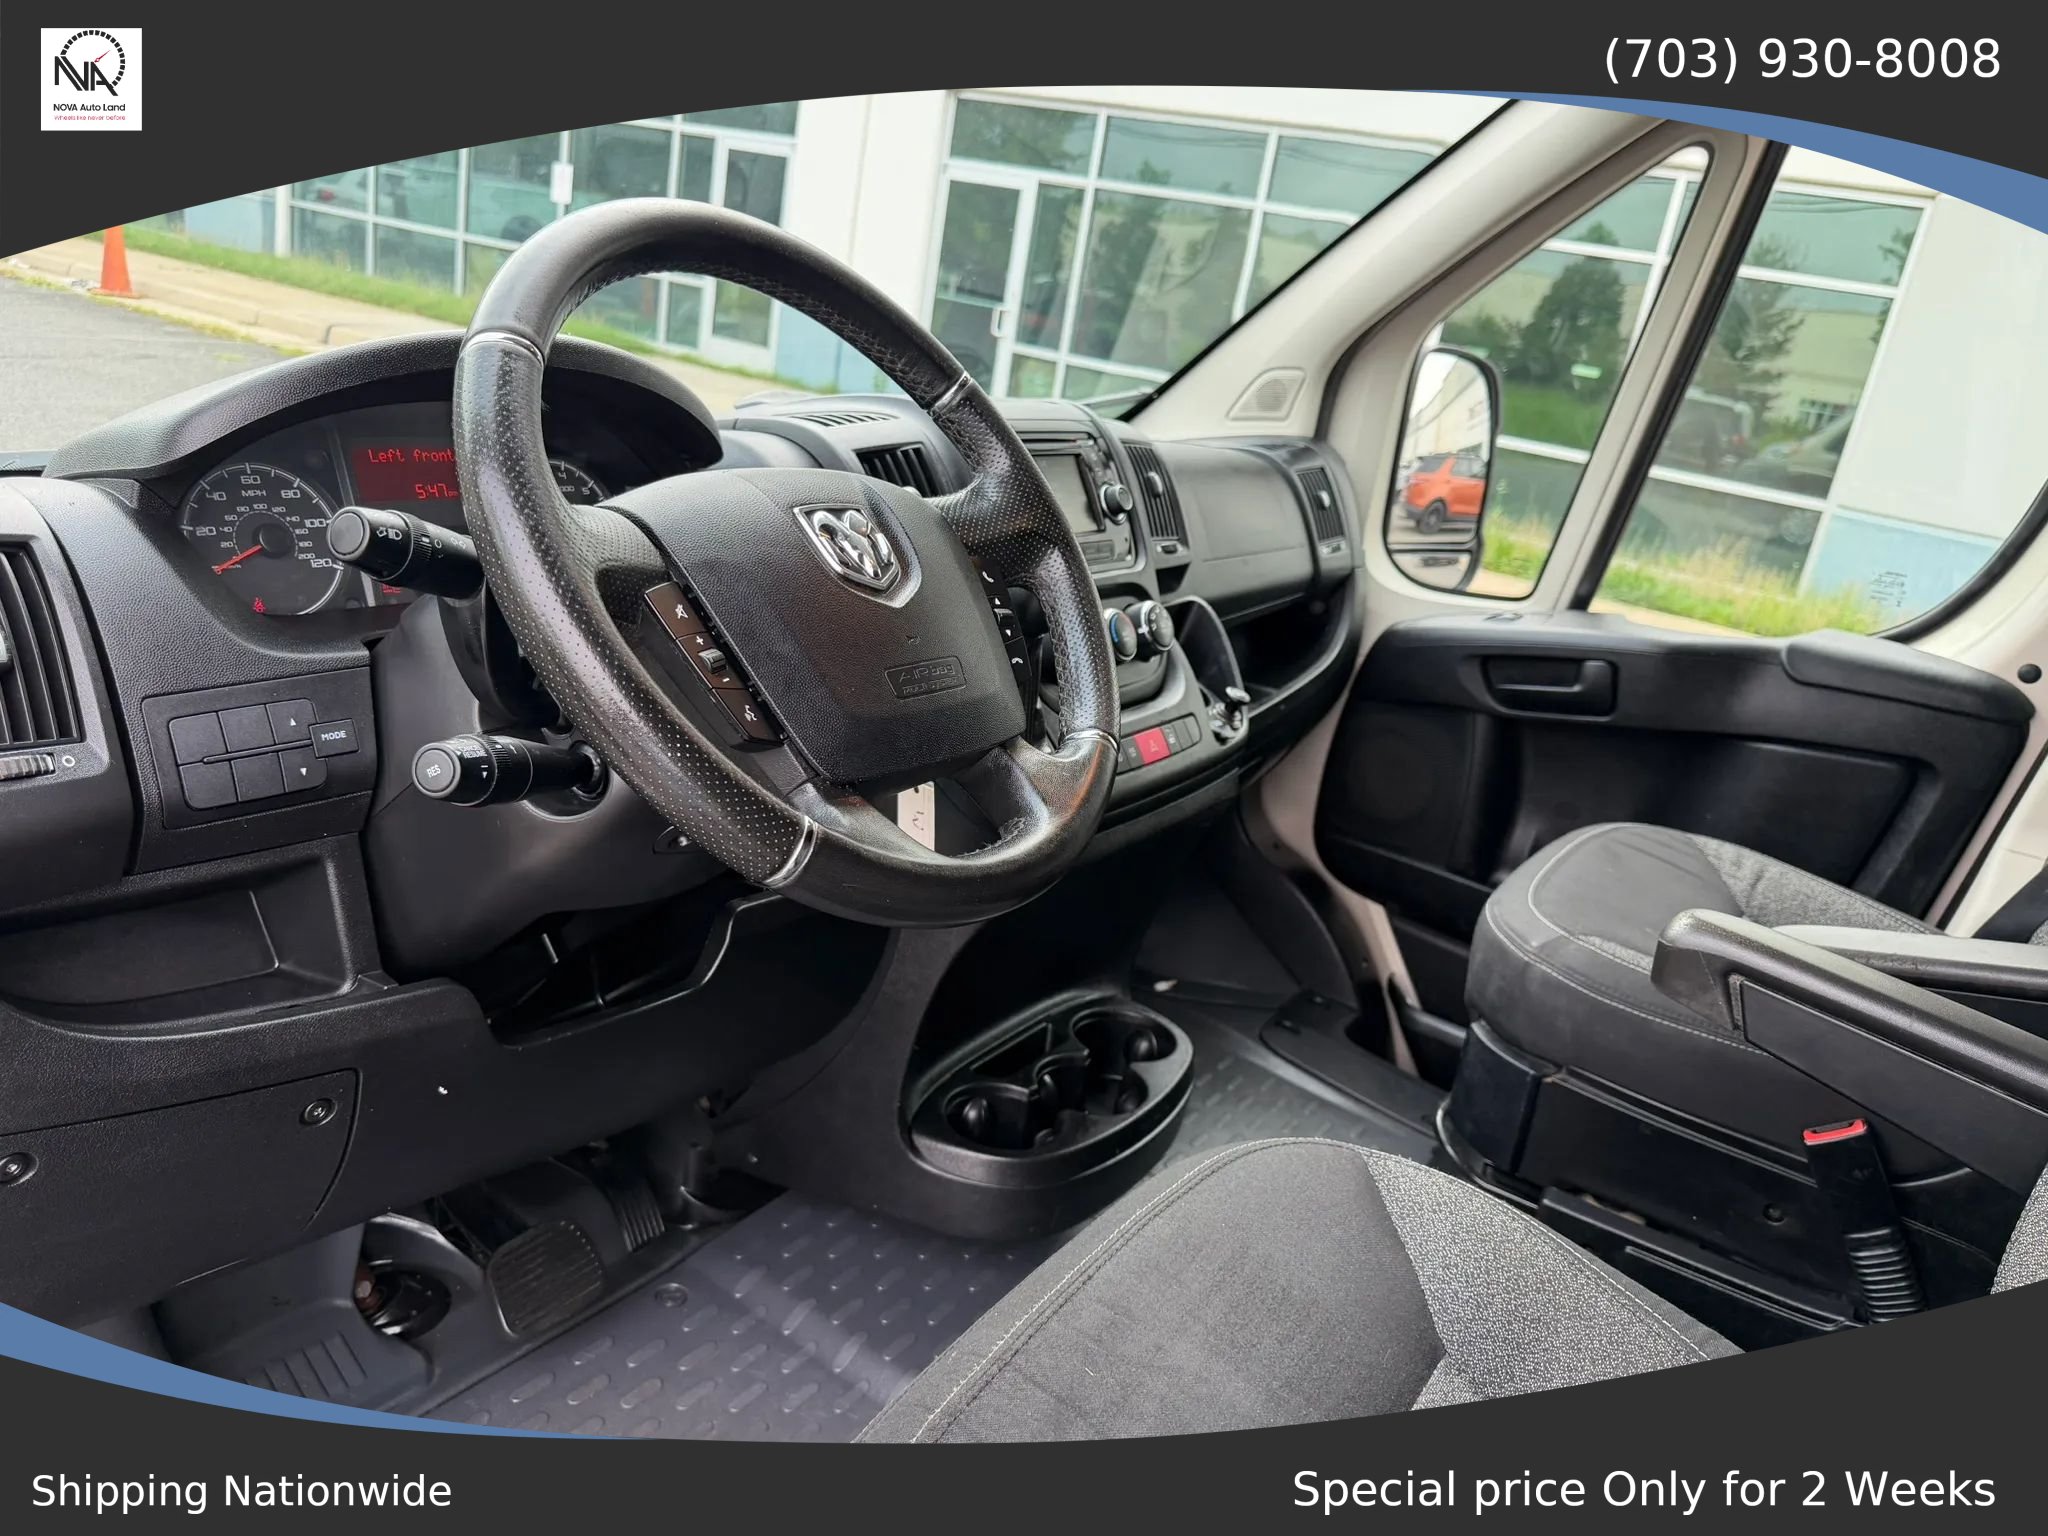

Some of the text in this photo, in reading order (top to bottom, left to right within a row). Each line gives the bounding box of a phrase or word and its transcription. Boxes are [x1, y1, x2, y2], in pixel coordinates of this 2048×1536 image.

[368, 448, 454, 463] Left front
[240, 475, 261, 485] 60
[242, 488, 267, 497] MPH
[280, 489, 301, 499] 80
[416, 483, 448, 499] 5:47
[582, 487, 591, 496] 5
[206, 491, 227, 502] 40
[304, 518, 327, 528] 100
[195, 526, 217, 537] 20
[310, 558, 334, 568] 120
[320, 730, 347, 741] MODE
[426, 764, 442, 779] RES
